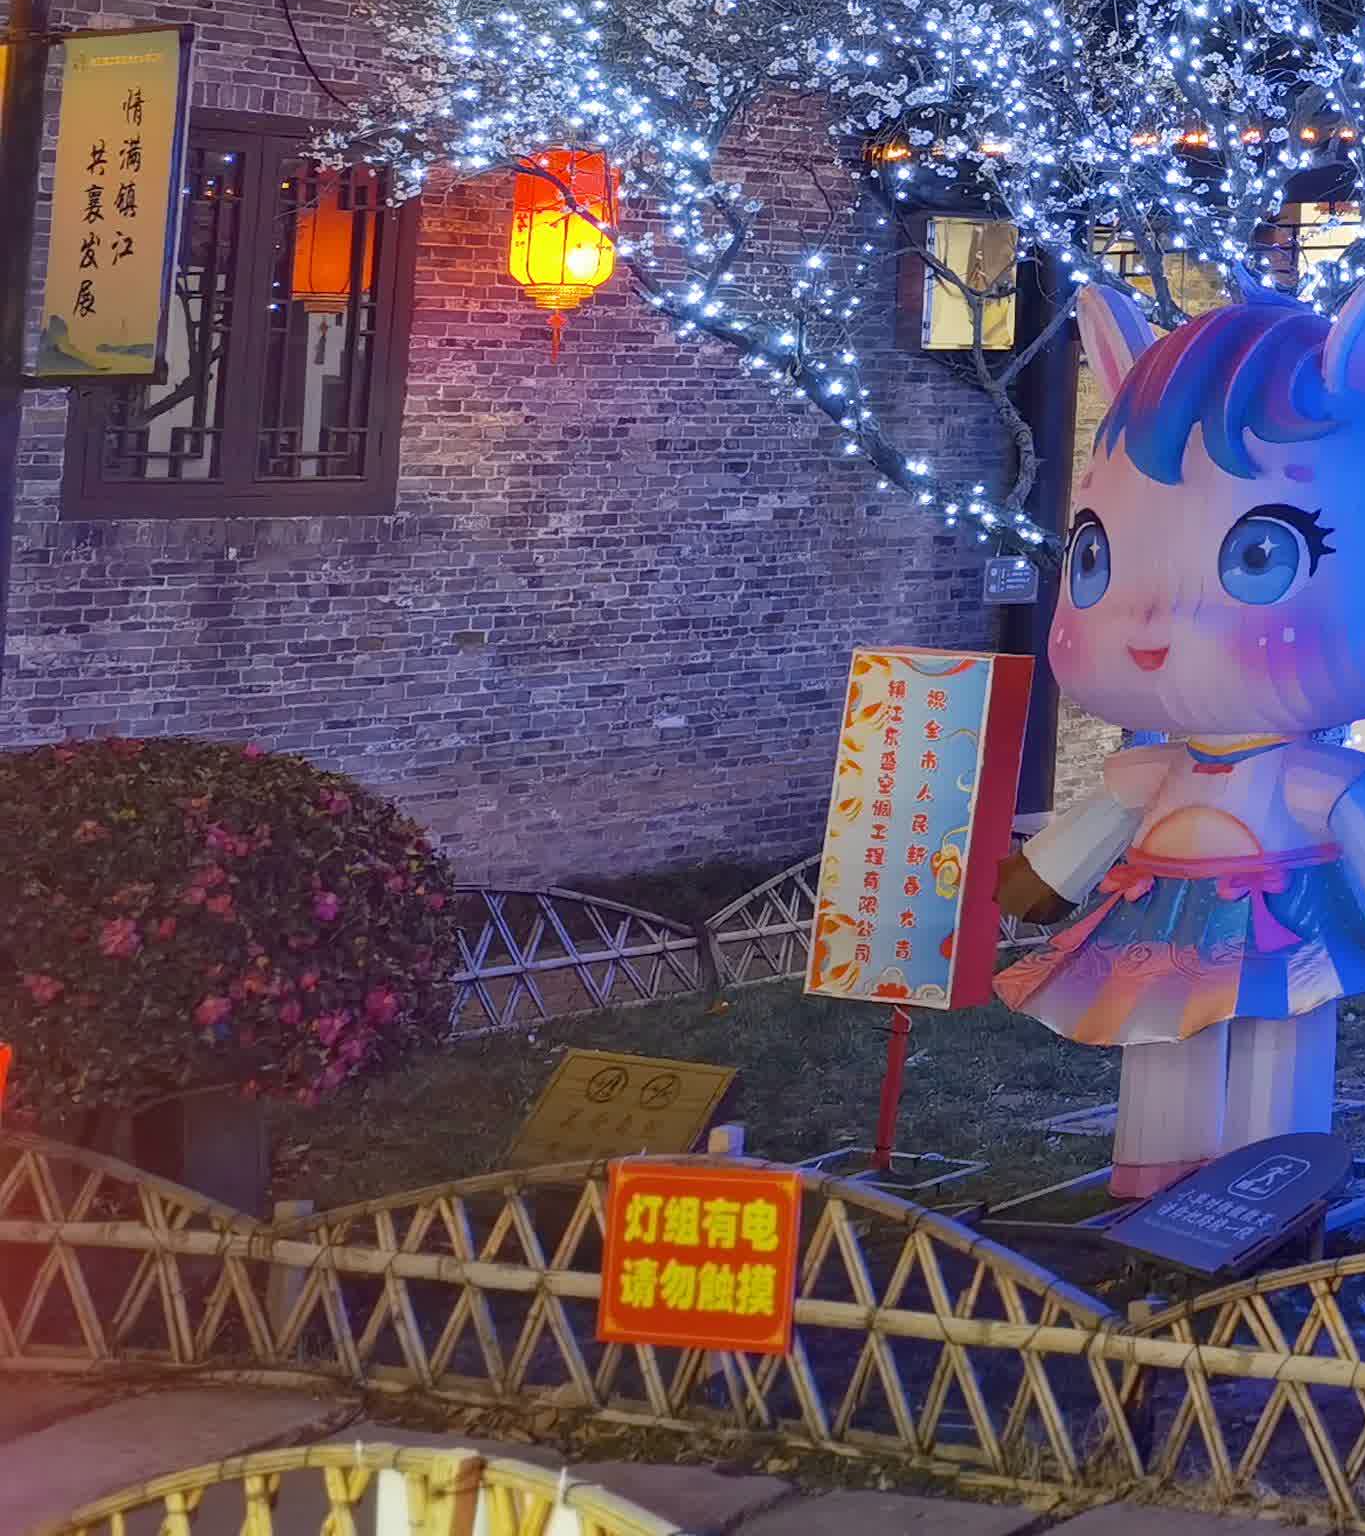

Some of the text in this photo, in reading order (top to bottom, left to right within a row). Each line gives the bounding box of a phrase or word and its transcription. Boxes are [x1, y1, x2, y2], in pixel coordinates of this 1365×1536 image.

[73, 137, 108, 318] 共襄发展
[110, 88, 146, 267] 情满镇江
[894, 688, 948, 962] 祝全市人民新春大吉
[619, 1258, 777, 1317] 请勿触摸
[623, 1192, 780, 1253] 灯组有电
